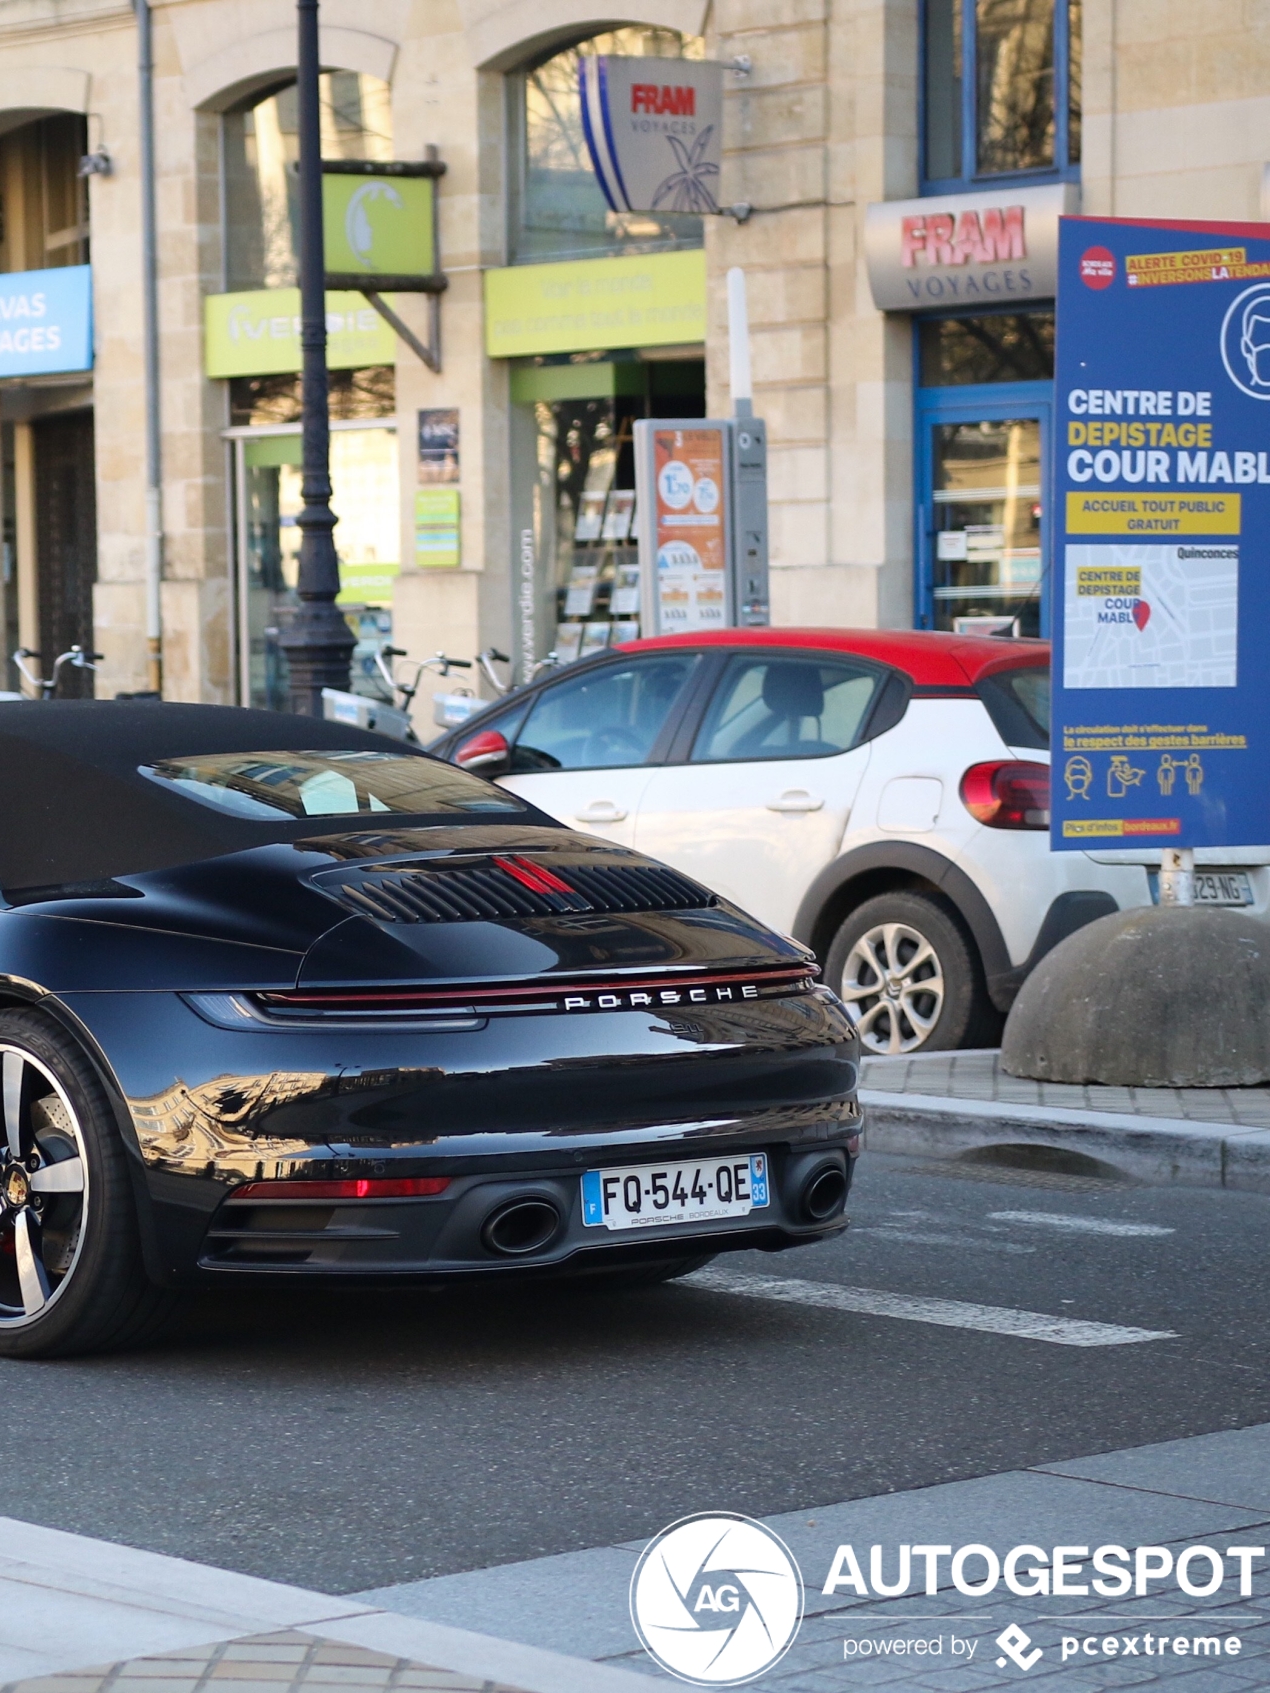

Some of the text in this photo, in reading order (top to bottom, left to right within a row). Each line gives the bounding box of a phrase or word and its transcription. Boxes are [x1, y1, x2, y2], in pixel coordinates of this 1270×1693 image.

[632, 84, 695, 116] FRAM
[630, 120, 697, 134] VOYAGES
[902, 205, 1027, 268] FRAM
[1127, 250, 1244, 271] ALERTE COVID-19
[907, 270, 1033, 298] VOYAGES
[1068, 389, 1211, 416] CENTRE DE
[1068, 421, 1212, 447] DEPISTAGE
[1067, 449, 1270, 484] COUR MABL
[1083, 500, 1226, 514] ACCUEIL TOUT PUBLIC
[1128, 518, 1180, 531] GRATUIT
[1177, 547, 1239, 560] Quinconces
[1080, 571, 1141, 582] CENTRE DE
[1078, 585, 1140, 596] DEPISTAGE
[1105, 598, 1142, 610] COUR
[1097, 612, 1140, 624] MABLY
[1075, 725, 1120, 734] circulation
[1063, 733, 1246, 749] le respect des gestes barrières
[1124, 820, 1179, 833] bordeaux.fr
[564, 985, 758, 1010] PORSCHE
[602, 1164, 766, 1214] FQ-544-QE 33
[589, 1203, 597, 1215] F
[631, 1209, 729, 1225] PORSCHE BORDEAUX
